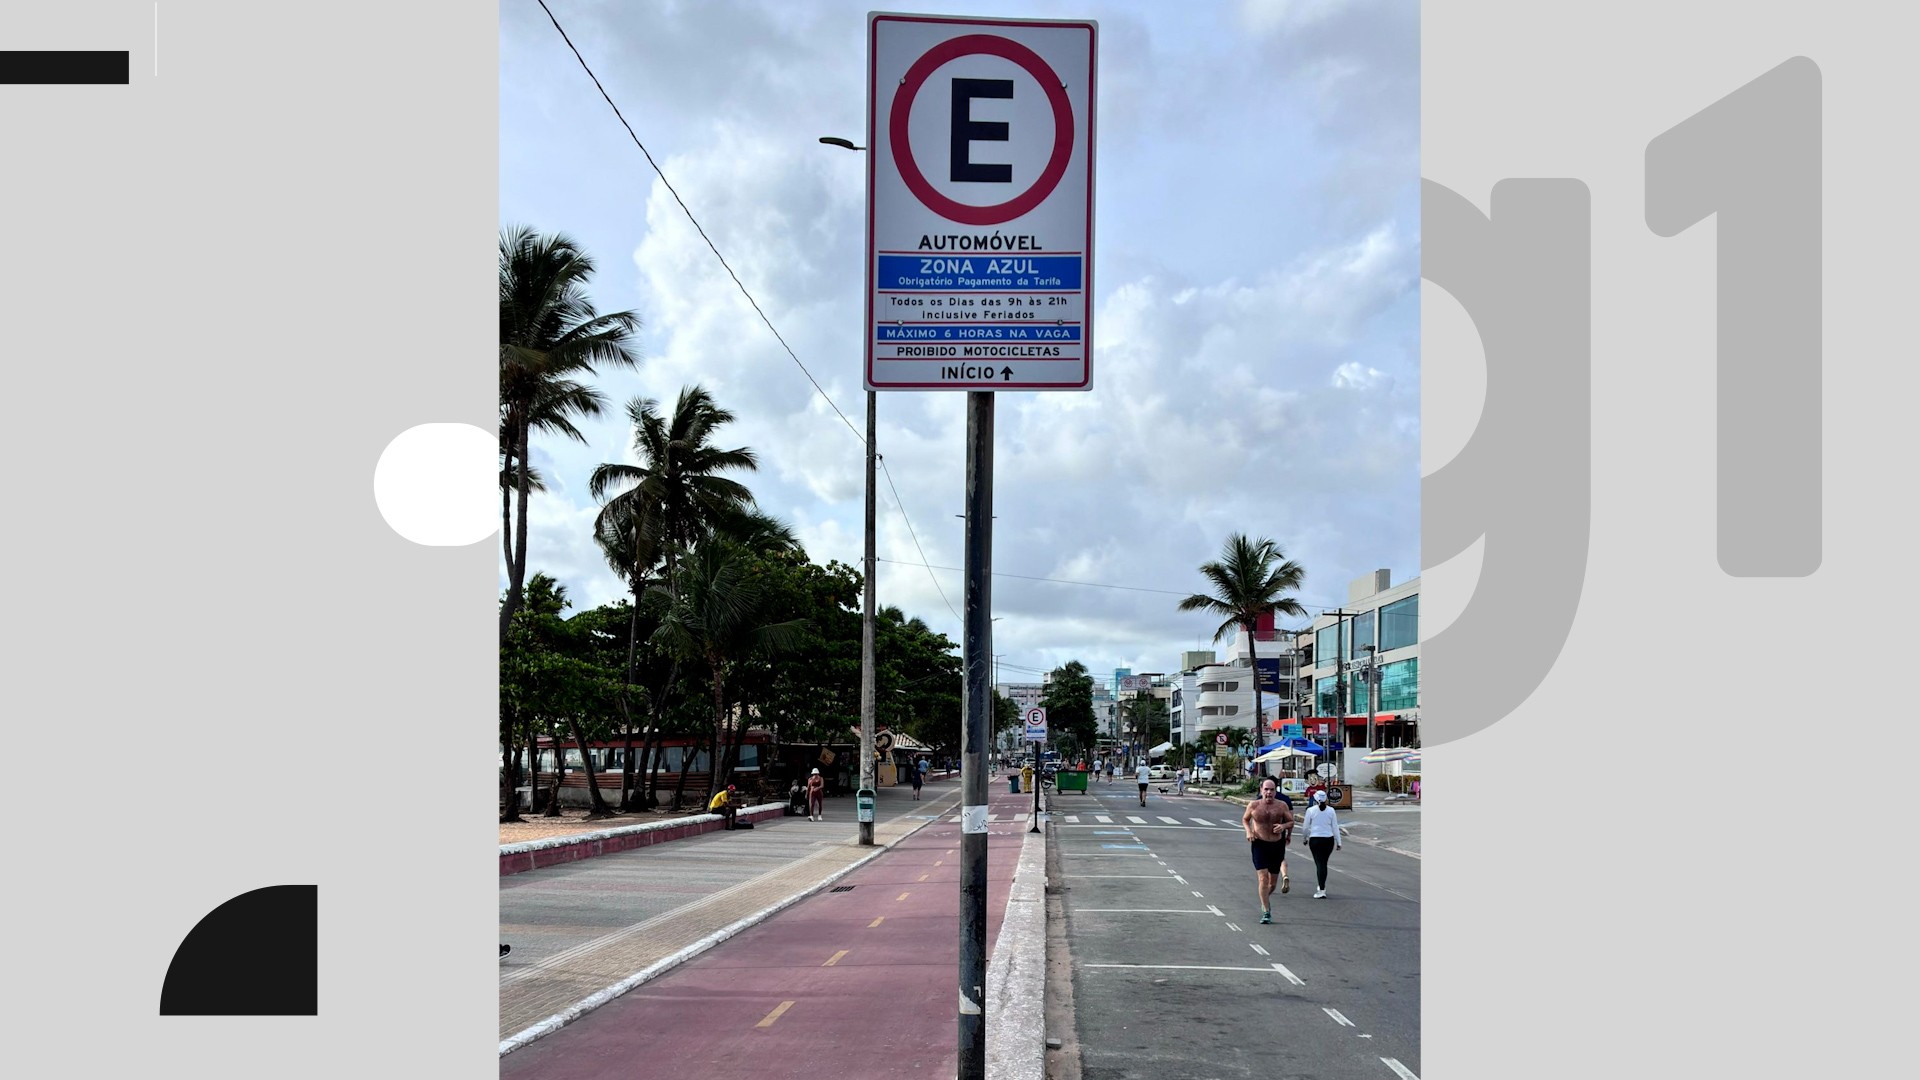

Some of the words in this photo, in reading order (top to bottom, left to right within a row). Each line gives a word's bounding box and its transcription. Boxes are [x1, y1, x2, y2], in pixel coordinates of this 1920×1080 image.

[950, 78, 1014, 183] E
[918, 231, 1042, 251] AUTOMÓVEL
[920, 259, 974, 274] ZONA
[986, 259, 1039, 274] AZUL
[898, 276, 953, 287] Obrigatório
[957, 277, 1011, 288] Pagamento
[1016, 277, 1029, 286] da
[1033, 277, 1061, 286] Tarifa
[890, 297, 924, 306] Todos
[949, 297, 975, 306] Dias
[980, 297, 1002, 306] das
[1007, 297, 1022, 306] 9h
[1028, 296, 1042, 306] às
[1048, 297, 1068, 306] 21h
[983, 310, 1035, 319] Feriados
[886, 327, 937, 338] MÁXIMO
[944, 329, 952, 338] 6
[958, 328, 1003, 338] HORAS
[1009, 329, 1028, 338] NA
[1035, 329, 1071, 338] VAGA
[896, 346, 957, 357] PROIBIDO
[963, 346, 1060, 357] MOTOCICLETAS
[941, 362, 995, 380] INÍCIO
[1033, 712, 1039, 722] E
